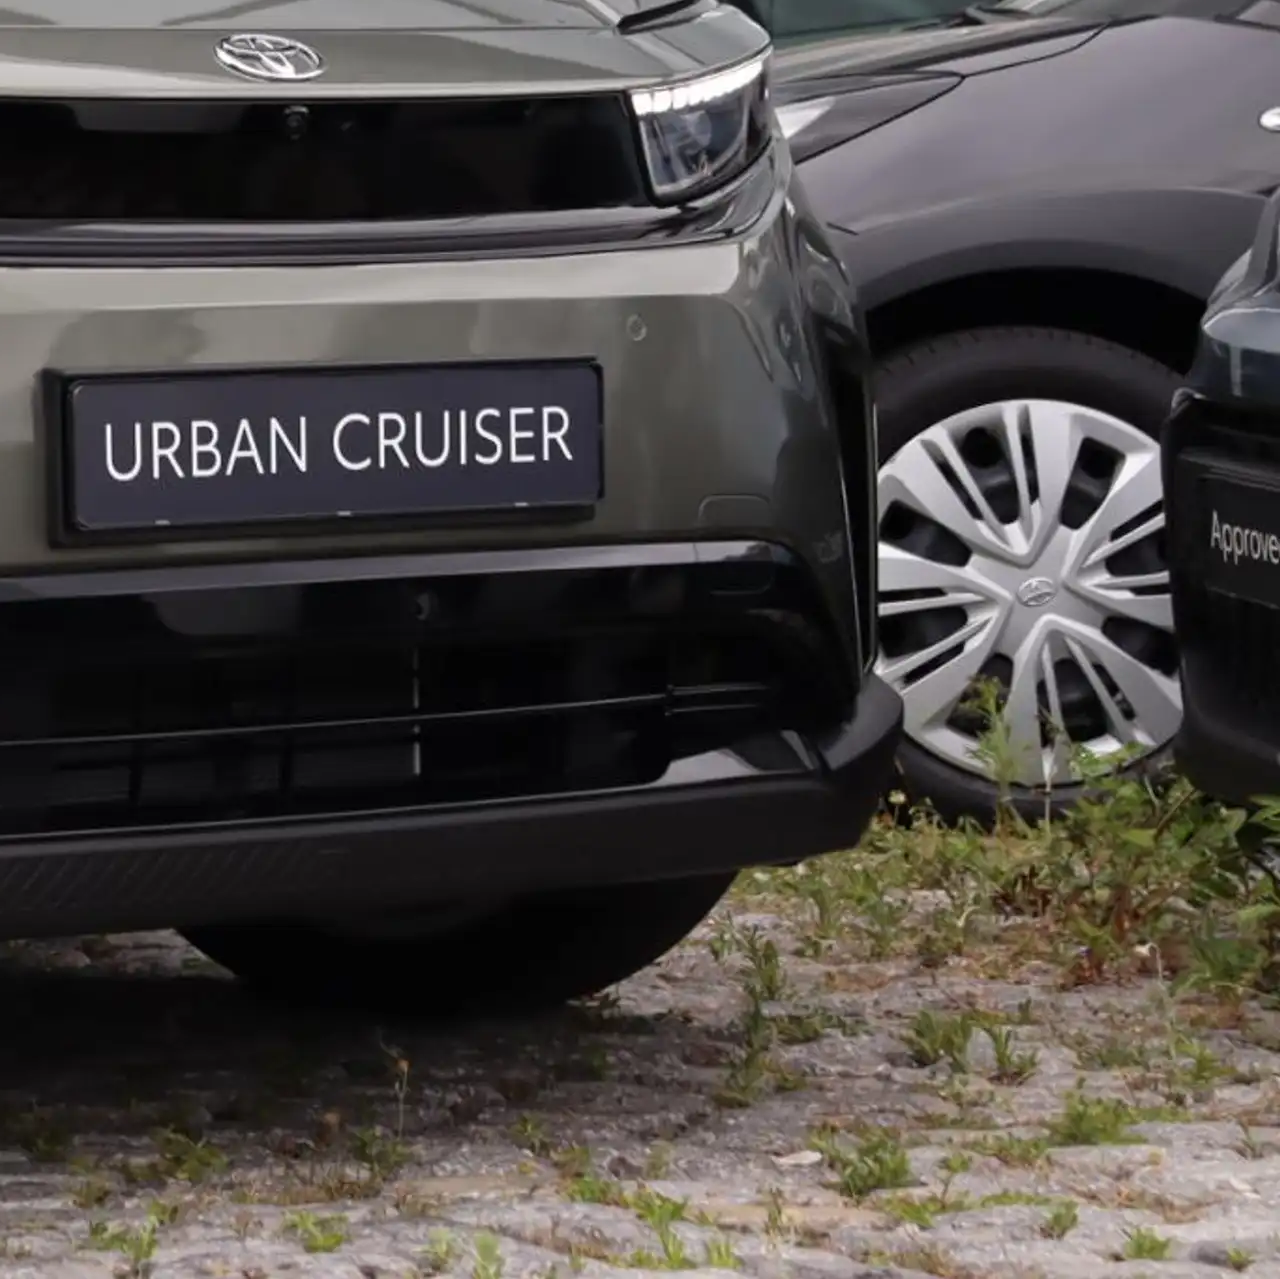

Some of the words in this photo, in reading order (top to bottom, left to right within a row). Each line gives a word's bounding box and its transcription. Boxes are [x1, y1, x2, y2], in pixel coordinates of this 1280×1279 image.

[105, 416, 308, 482] URBAN
[333, 406, 574, 471] CRUISER
[1210, 508, 1280, 565] Approve
